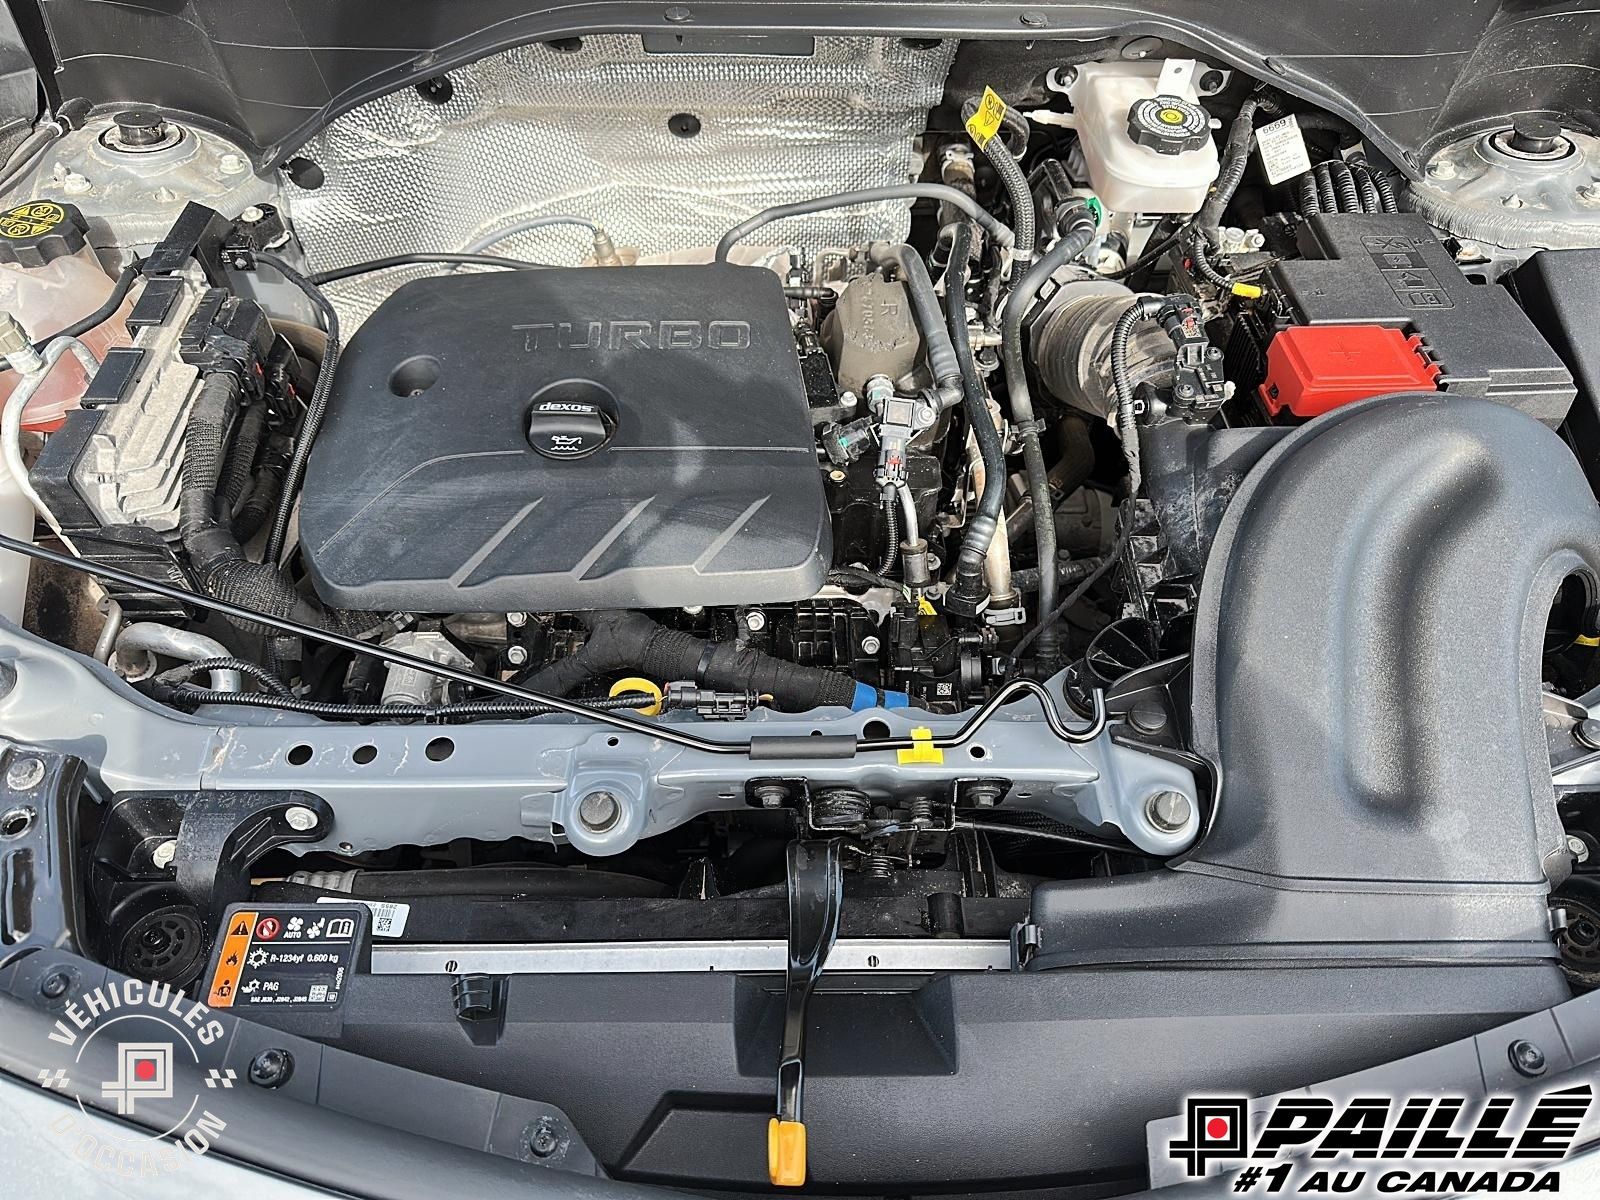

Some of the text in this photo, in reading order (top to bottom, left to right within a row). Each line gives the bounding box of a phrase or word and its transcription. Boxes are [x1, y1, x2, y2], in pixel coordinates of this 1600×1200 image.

[1262, 119, 1286, 134] 6669
[511, 320, 752, 351] TURBO
[538, 401, 595, 413] dexos
[283, 931, 302, 939] AUTO
[270, 953, 339, 965] R-1234yf 0.600 kg
[262, 981, 280, 991] PAG
